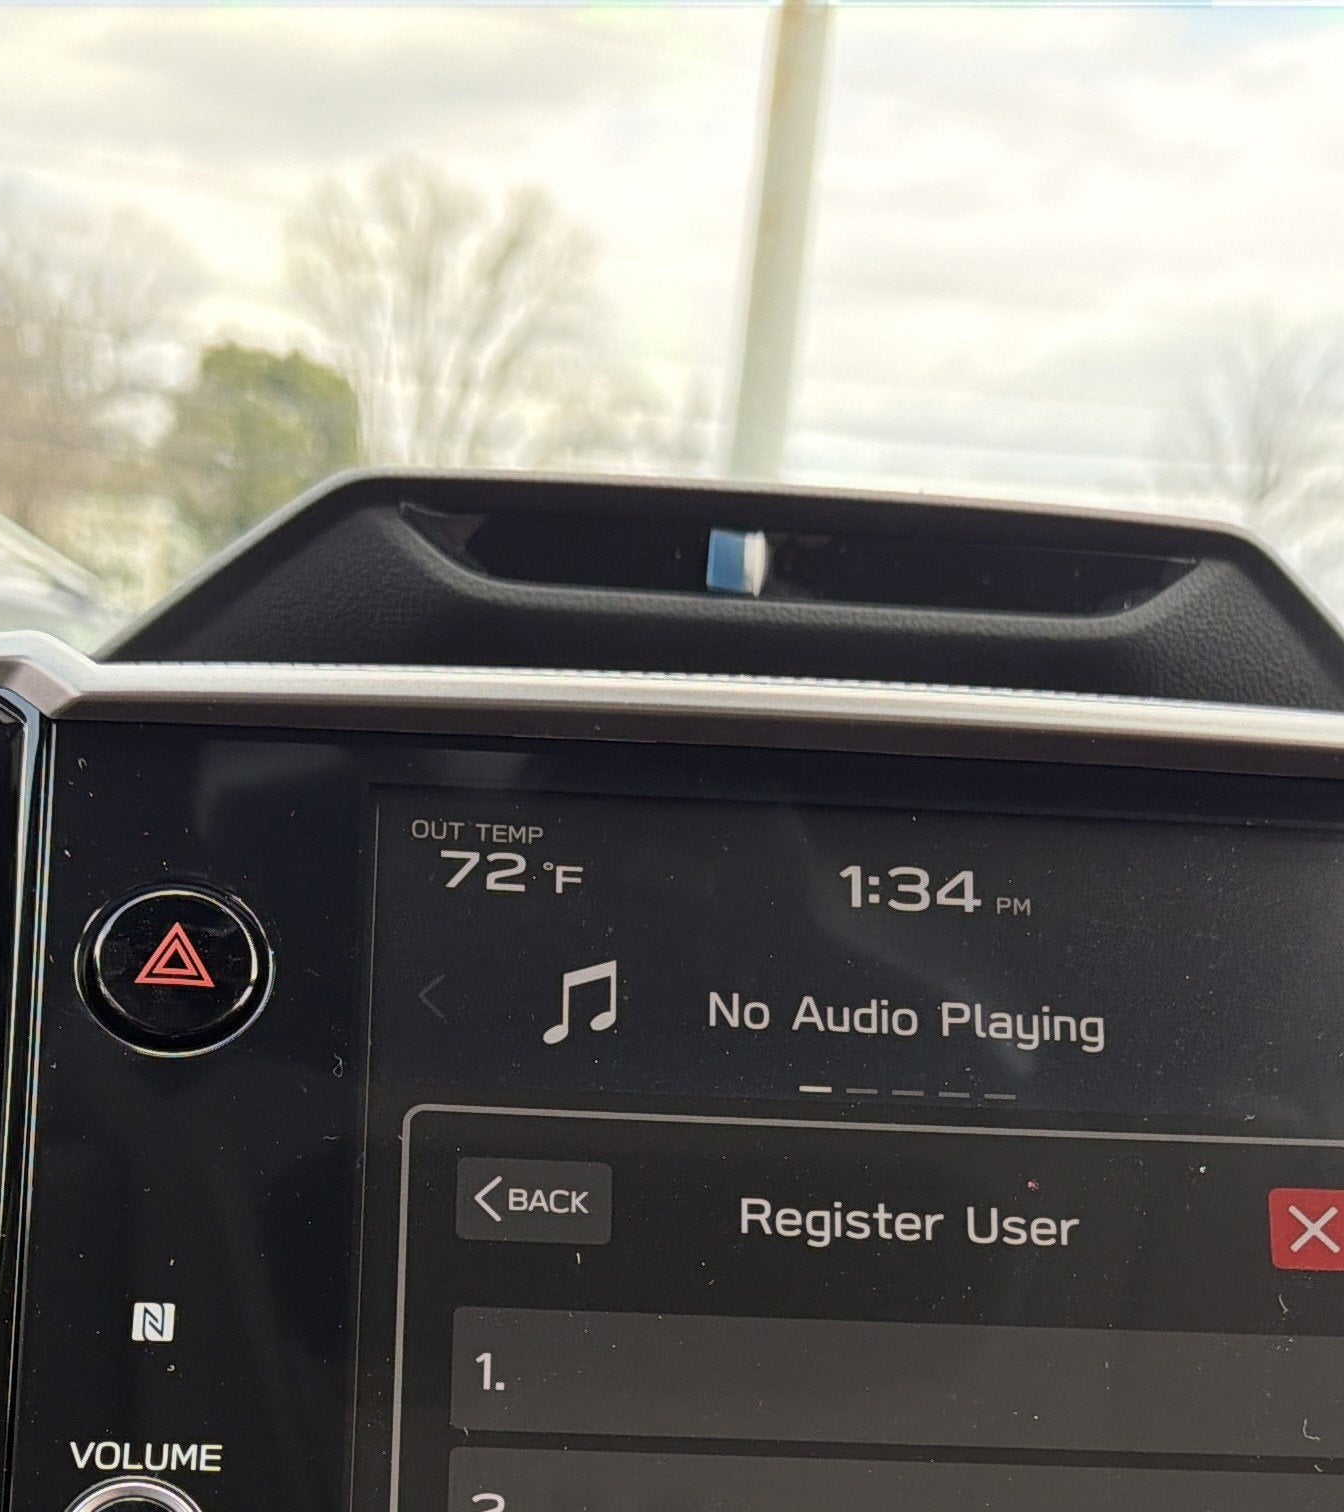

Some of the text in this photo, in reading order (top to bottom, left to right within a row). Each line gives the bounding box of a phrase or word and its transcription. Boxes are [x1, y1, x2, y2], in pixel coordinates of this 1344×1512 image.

[411, 819, 545, 845] OUT TEMP
[440, 849, 527, 892] 72
[839, 865, 1032, 916] 1:34 PM
[709, 991, 1105, 1053] No Audio Playing
[508, 1188, 590, 1214] BACK
[740, 1197, 1080, 1248] Register User
[475, 1352, 506, 1391] 1.
[69, 1441, 223, 1472] VOLUME
